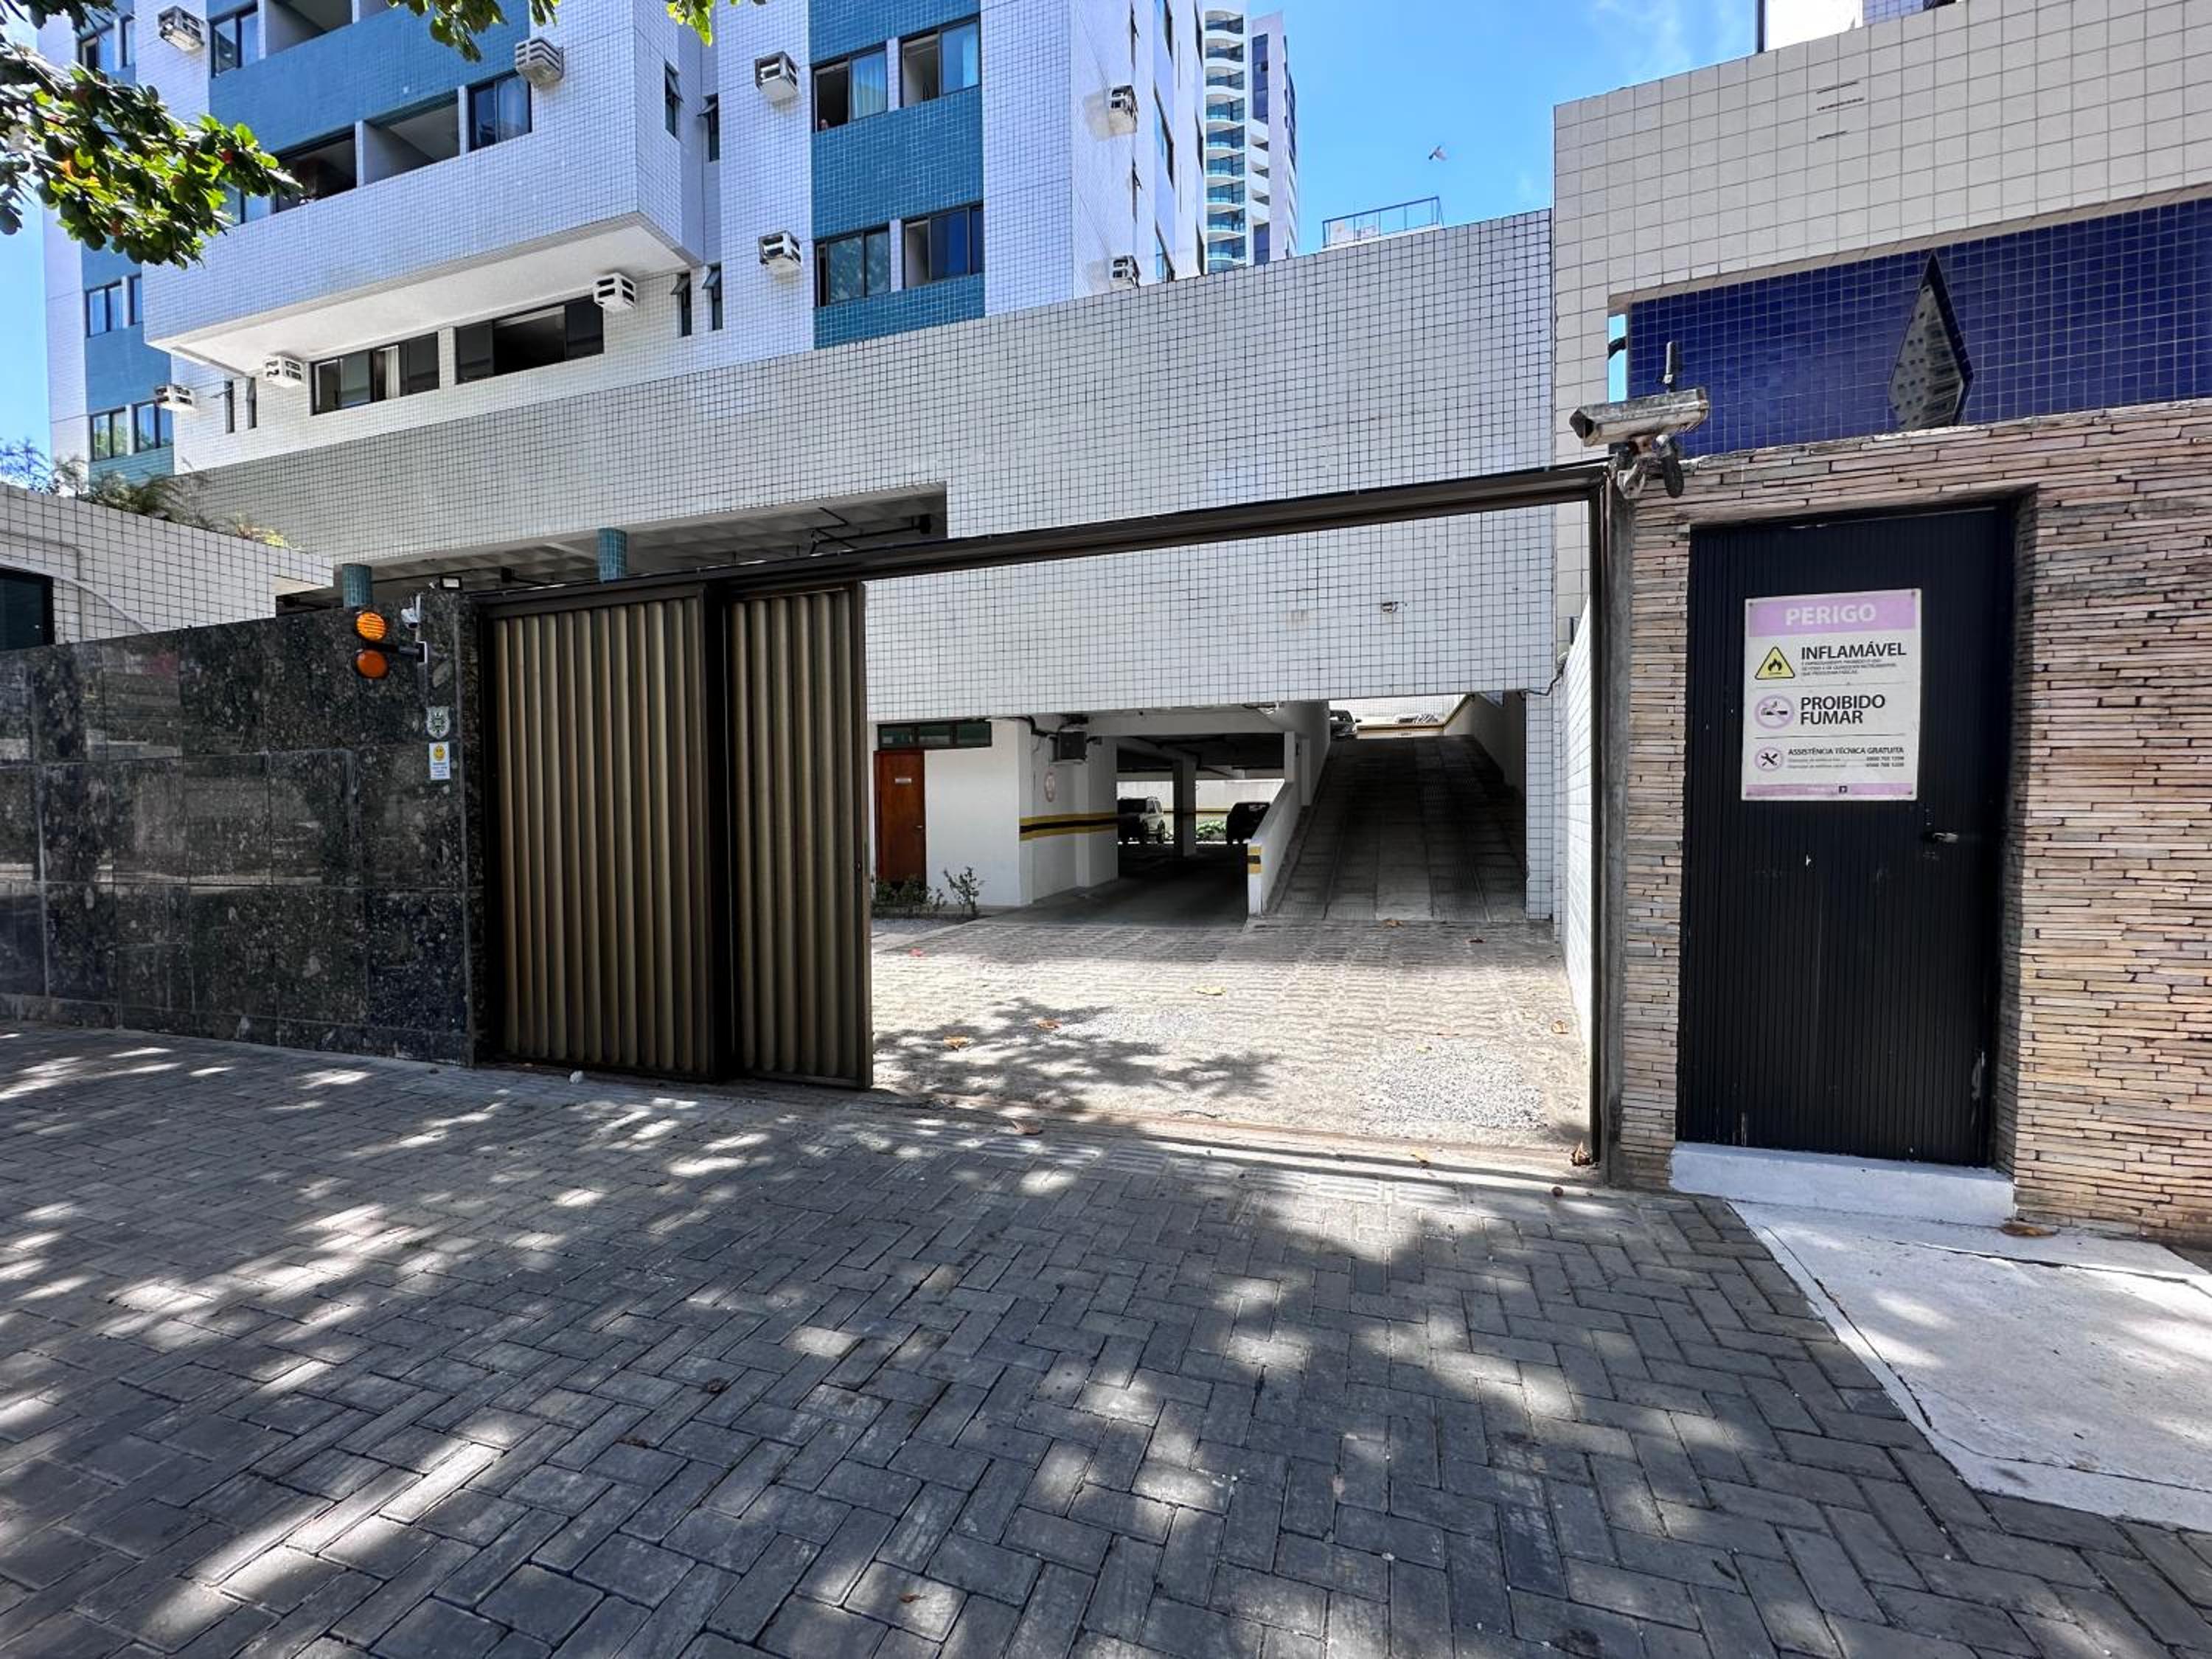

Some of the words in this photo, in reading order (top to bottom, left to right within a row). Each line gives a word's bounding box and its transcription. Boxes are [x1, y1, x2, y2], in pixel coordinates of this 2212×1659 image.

[1785, 604, 1876, 625] PERIGO
[1801, 641, 1907, 660] INFLAMÁVEL
[1801, 695, 1885, 711] PROIBIDO
[1800, 710, 1863, 725] FUMAR
[1788, 746, 1833, 756] ASSISTÊNCIA
[1834, 745, 1865, 754] TÉCNICA
[1866, 746, 1905, 754] GRATUITA
